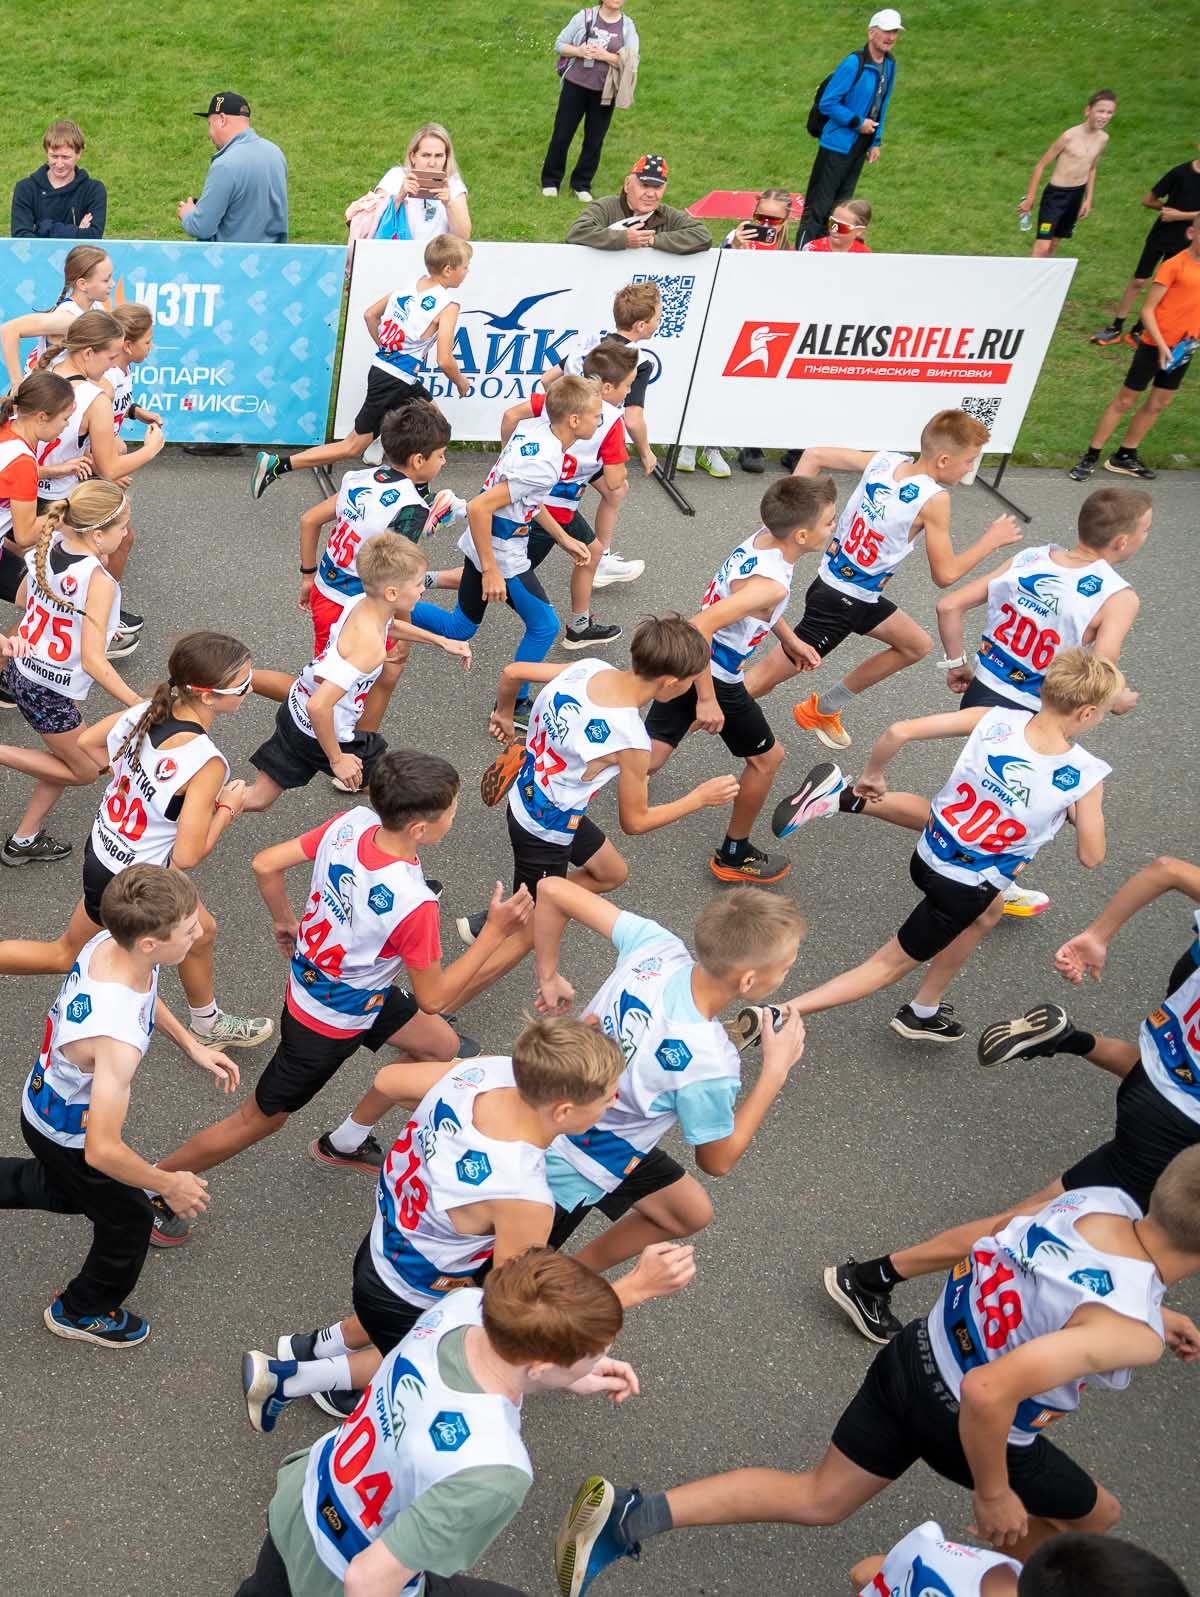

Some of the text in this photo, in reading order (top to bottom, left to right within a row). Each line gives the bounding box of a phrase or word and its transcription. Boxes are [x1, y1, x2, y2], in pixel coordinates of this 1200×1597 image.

[135, 282, 221, 327] ИЗТТ
[798, 323, 1025, 360] ALEKSRIFLE.RU
[131, 366, 227, 386] НОПАРК
[844, 511, 885, 567] 95
[1017, 596, 1050, 618] СТРИЖ
[993, 603, 1061, 671] 206
[981, 778, 1019, 808] СТРИЖ
[941, 782, 1027, 853] 208
[375, 1386, 393, 1443] СТРИЖ
